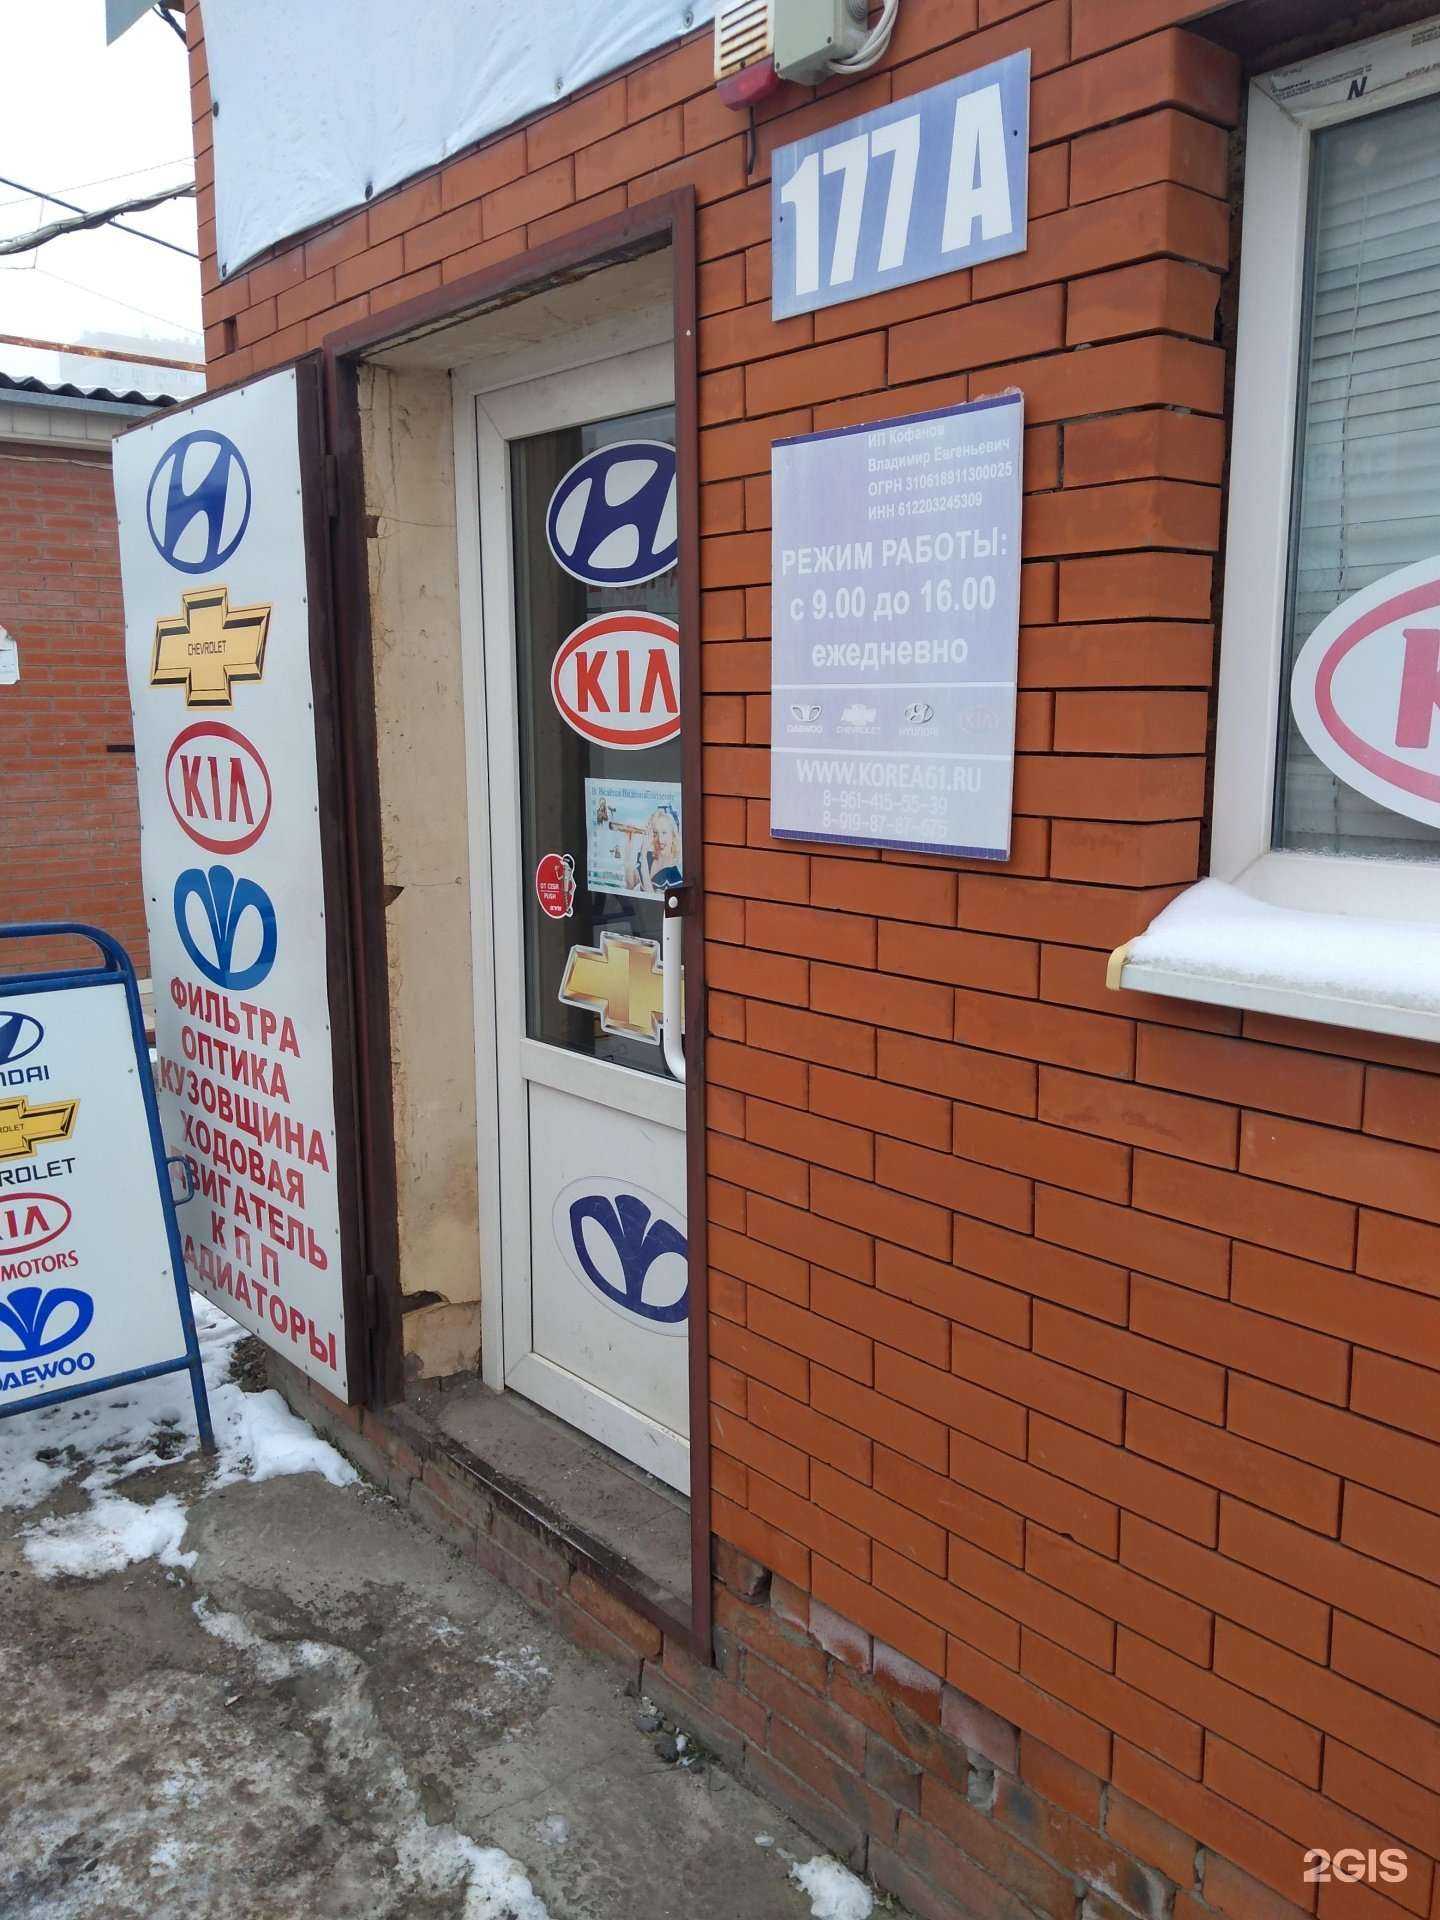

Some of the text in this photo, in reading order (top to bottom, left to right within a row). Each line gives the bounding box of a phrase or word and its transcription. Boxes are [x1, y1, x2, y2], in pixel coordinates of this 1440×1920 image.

[781, 83, 1012, 296] 177 А
[868, 431, 886, 448] ИП
[868, 438, 1011, 473] Владимир Евгеньевич
[868, 478, 902, 497] ОГРН
[868, 503, 895, 520] ИНН
[781, 526, 1008, 577] РЕЖИМ РАБОТЫ:
[790, 575, 996, 622] с 9.00 до 16.00
[187, 639, 228, 657] CHEVROLET
[811, 638, 969, 671] ежедневно
[576, 648, 679, 714] KIA
[179, 755, 255, 825] KIA
[796, 758, 983, 793] WWW.KOREA61.RU
[170, 976, 301, 1058] ФИЛЬТРА
[182, 1025, 290, 1104] ОПТИКА
[159, 1056, 329, 1173] КУЗОВЩИНА
[180, 1109, 306, 1209] ХОДОВАЯ
[0, 1205, 50, 1240] IA
[1, 1250, 79, 1281] MOTORS
[182, 1234, 338, 1371] АДИАТОРЫ
[0, 1352, 96, 1392] AEWOO
